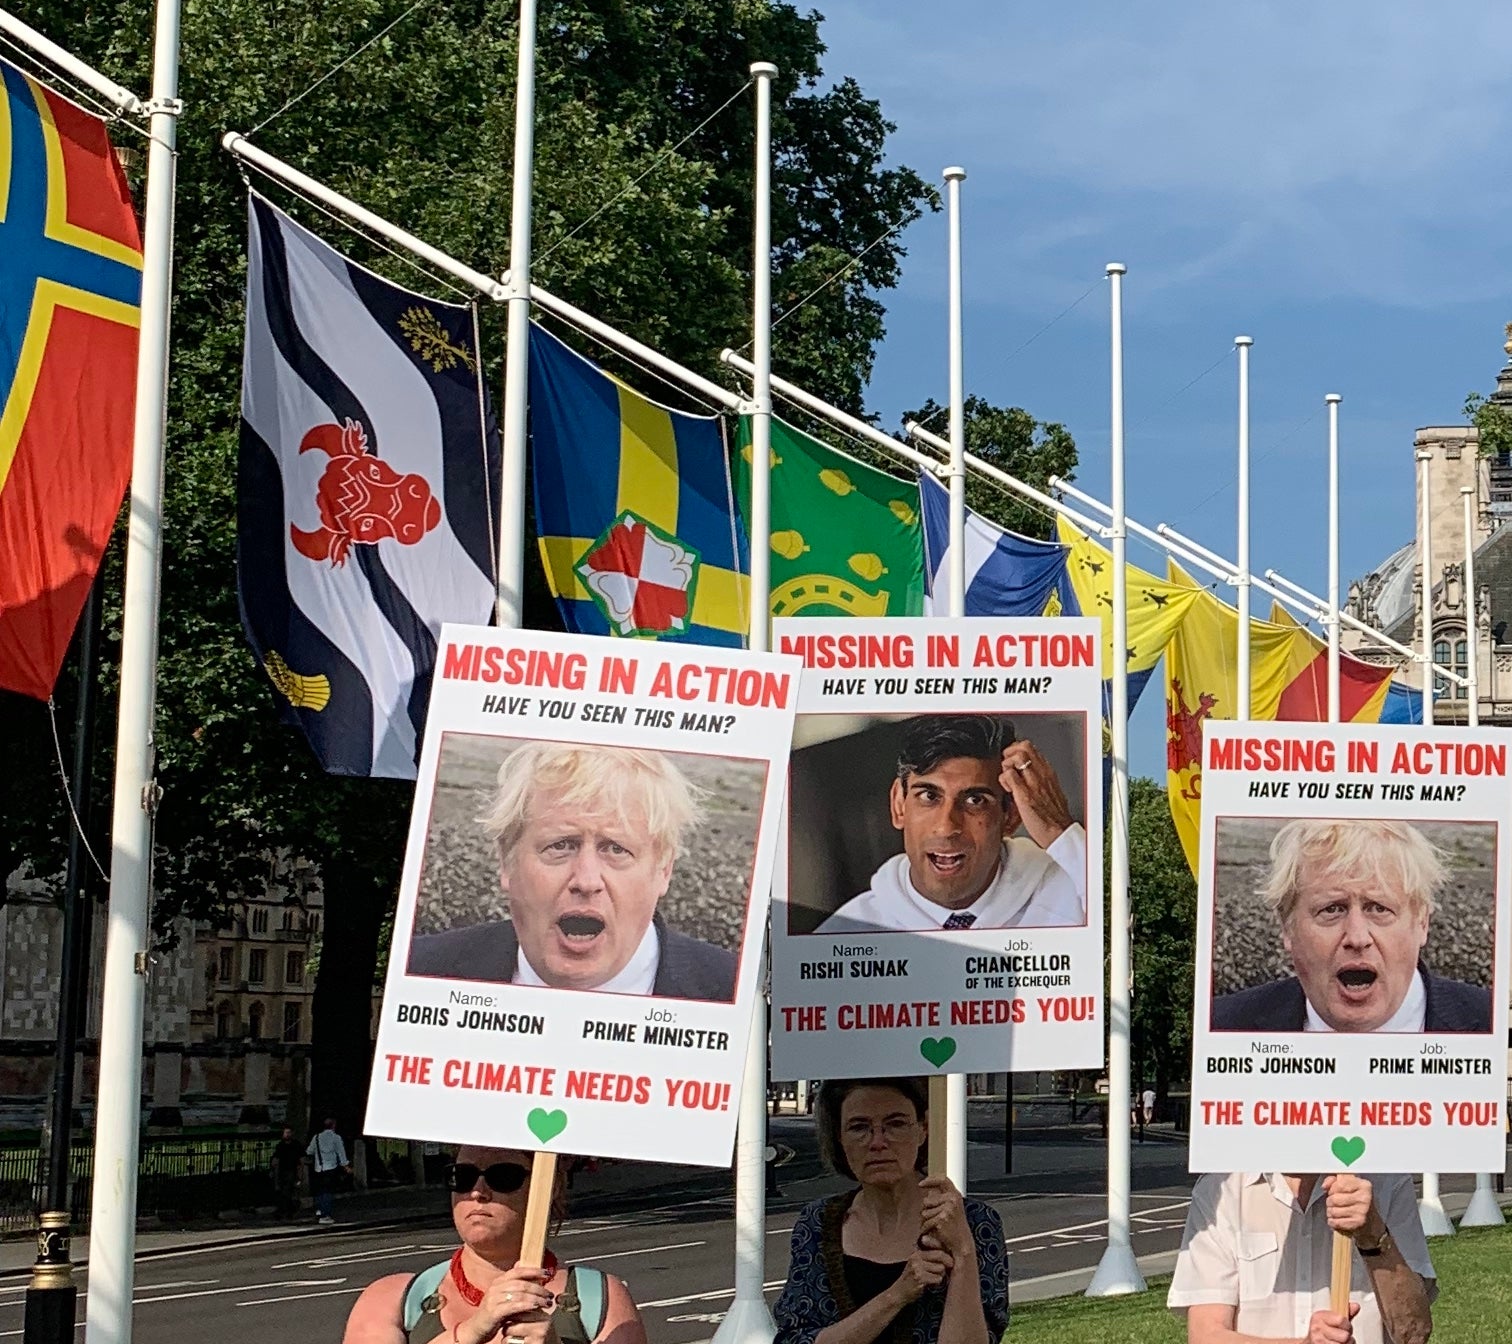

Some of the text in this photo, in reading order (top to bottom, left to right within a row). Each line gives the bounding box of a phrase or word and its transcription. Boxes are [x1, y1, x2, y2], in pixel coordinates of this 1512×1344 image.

[780, 634, 1094, 669] MISSING IN ACTION
[442, 642, 791, 710] MISSING IN ACTION
[822, 676, 1053, 696] HAVE YOU SEEN THIS MAN?
[482, 694, 737, 734] HAVE YOU SEEN THIS MAN?
[1209, 737, 1506, 777] MISSING IN ACTION
[1248, 781, 1467, 802] HAVE YOU SEEN THIS MAN?
[832, 944, 878, 957] Name:
[1003, 939, 1032, 953] Job:
[800, 959, 909, 980] RISHI SUNAK
[965, 954, 1071, 975] CHANCELLOR
[965, 974, 1071, 990] OF THE EXCHEQUER
[448, 990, 498, 1008] Name:
[396, 1004, 545, 1036] BORIS JOHNSON
[644, 1007, 677, 1024] Job:
[780, 996, 1095, 1033] THE CLIMATE NEEDS YOU!
[582, 1019, 729, 1051] PRIME MINISTER
[1251, 1041, 1294, 1054] Name:
[1419, 1042, 1447, 1055] Job:
[1206, 1056, 1336, 1075] BORIS JOHNSON
[1369, 1057, 1492, 1075] PRIME MINISTER
[385, 1053, 731, 1112] THE CLIMATE NEEDS YOU!
[1200, 1100, 1498, 1127] THE CLIMATE NEEDS YOU!
